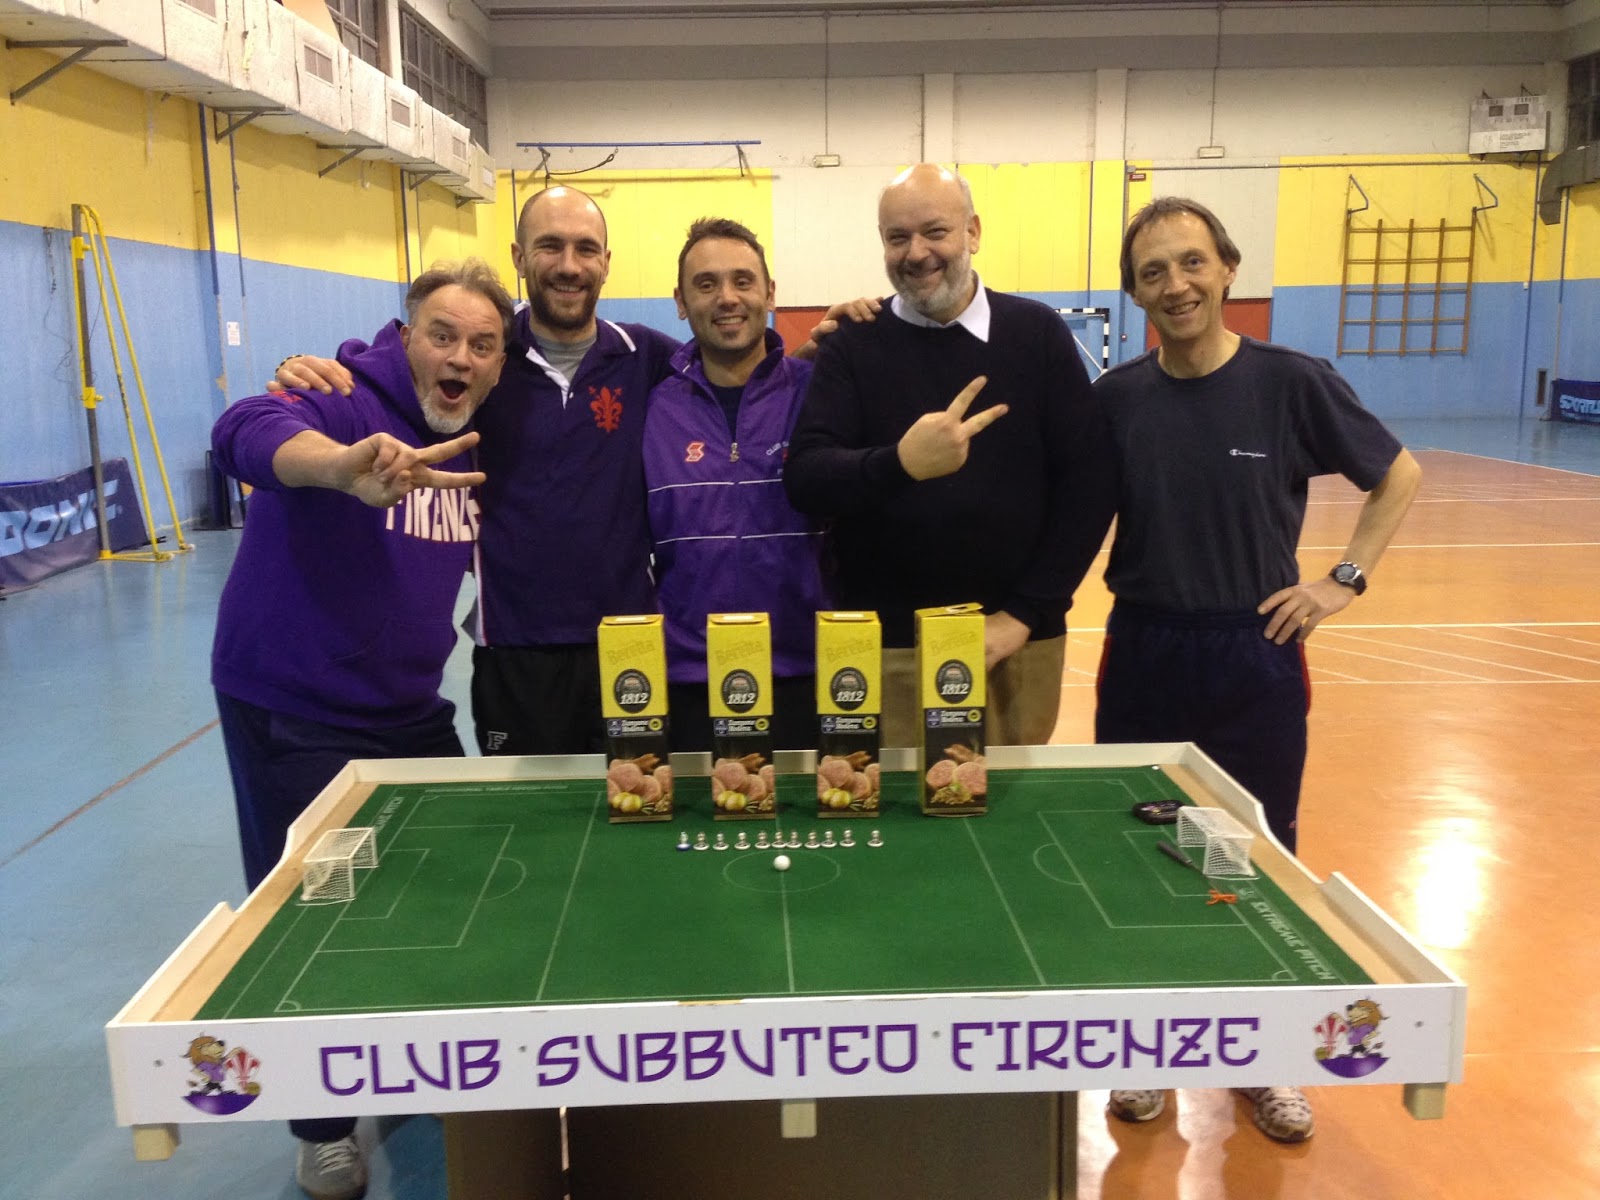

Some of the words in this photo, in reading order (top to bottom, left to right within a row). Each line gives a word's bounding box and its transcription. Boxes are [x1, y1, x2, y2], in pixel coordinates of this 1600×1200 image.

[940, 683, 970, 695] 1812
[619, 692, 650, 705] 1812
[726, 692, 756, 705] 1812
[835, 690, 866, 702] 1812
[319, 1039, 501, 1095] CLUB
[537, 1023, 918, 1087] SUBBUTEO
[951, 1017, 1260, 1071] FIRENZE
